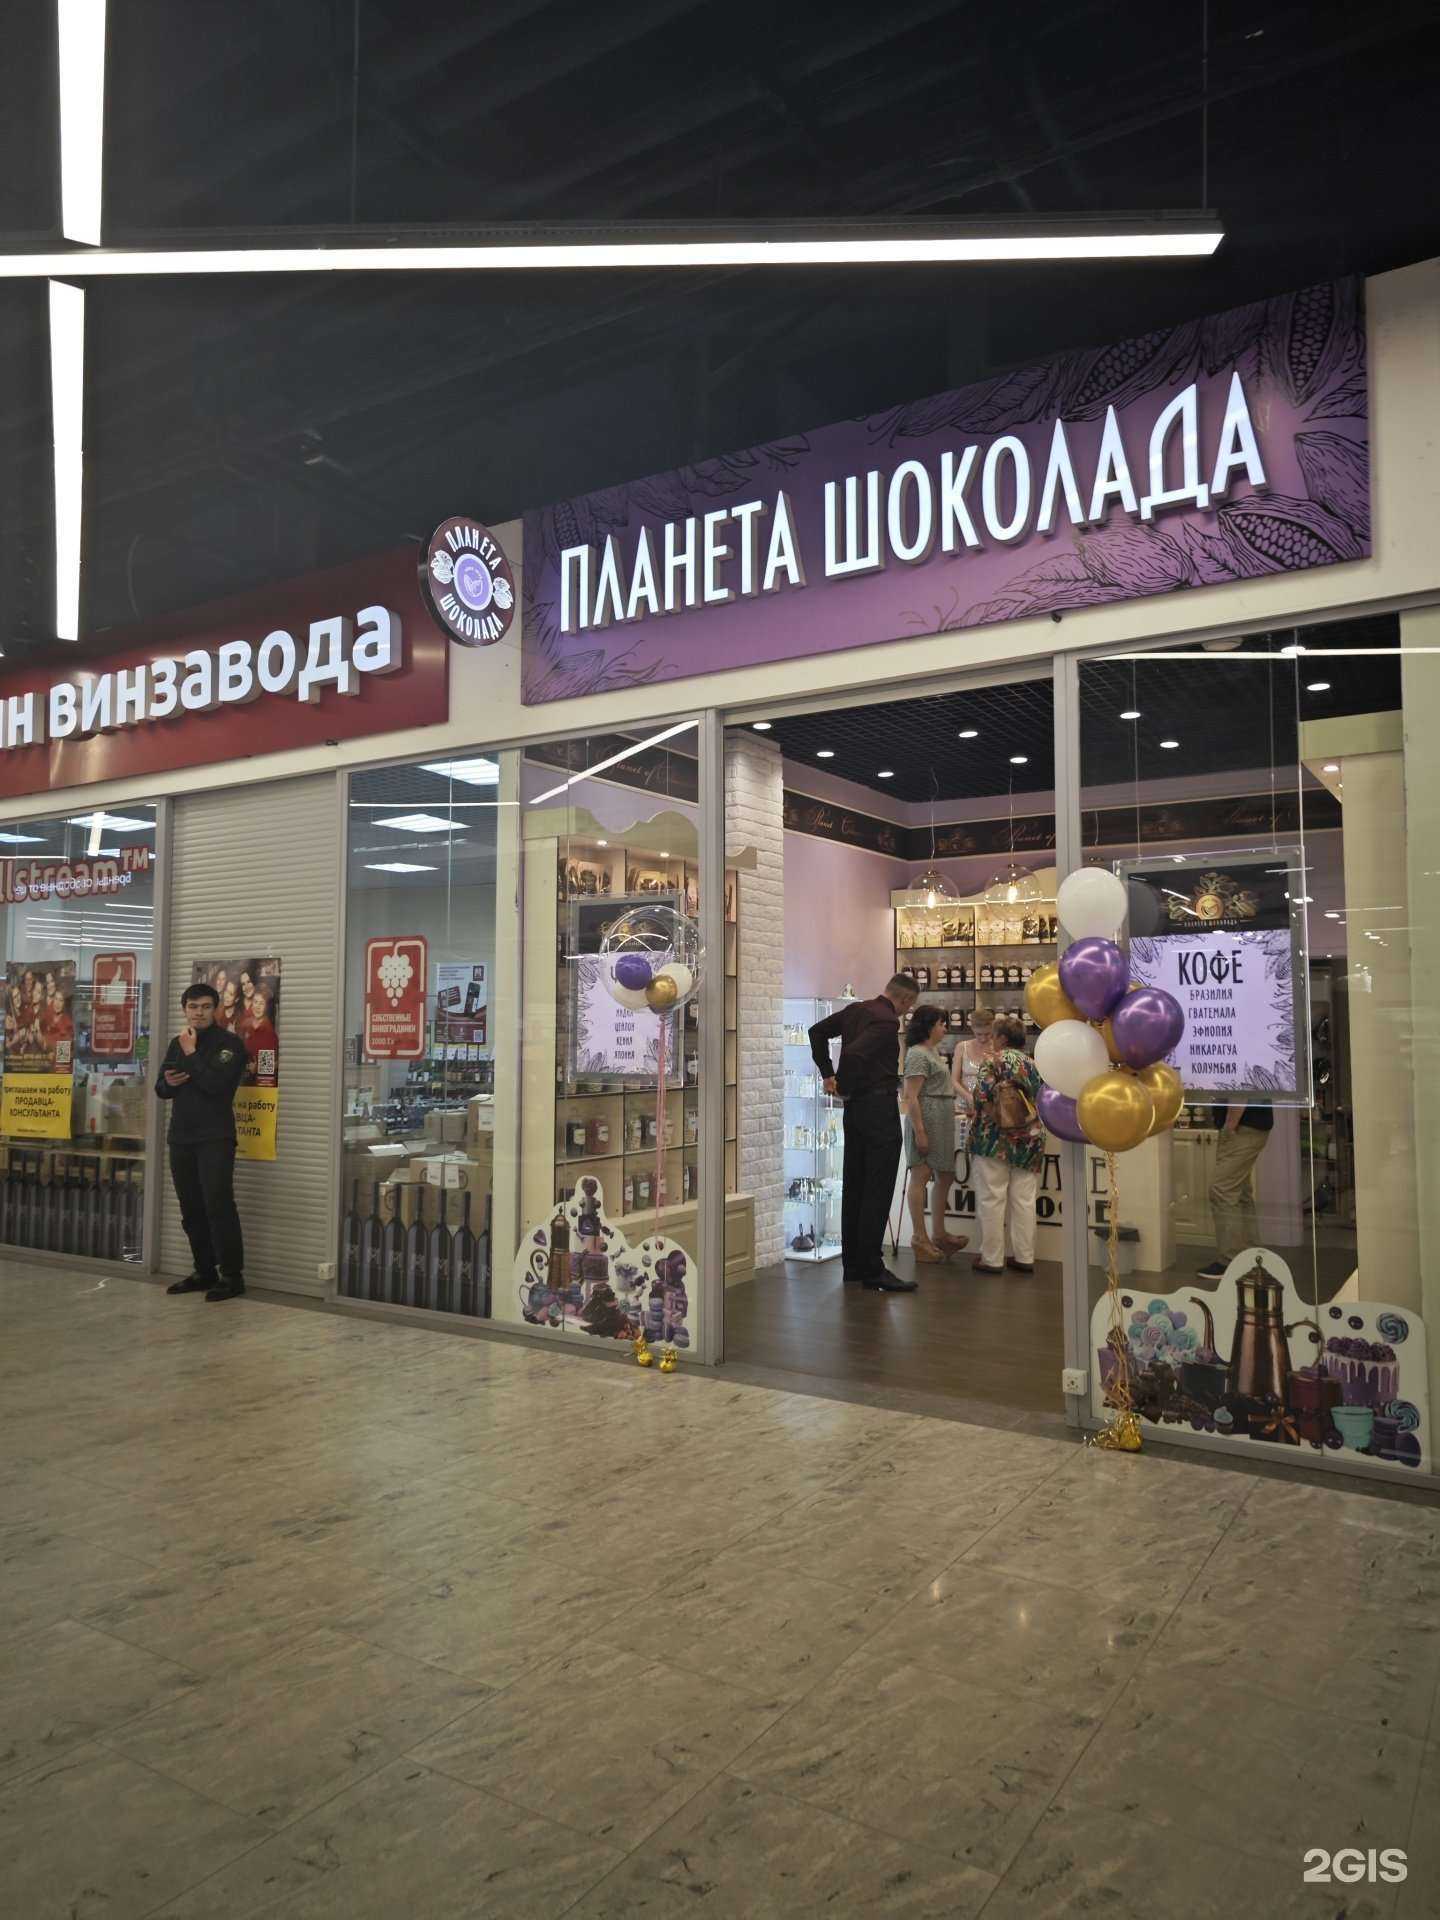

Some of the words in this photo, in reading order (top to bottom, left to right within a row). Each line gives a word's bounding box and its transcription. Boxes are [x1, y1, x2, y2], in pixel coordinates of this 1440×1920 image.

[560, 490, 804, 633] ПЛАНЕТА
[824, 371, 1267, 581] ШОКОЛАДА
[445, 526, 502, 571] ПЛАНЕТА
[440, 593, 504, 640] ШОКОЛАДА
[49, 605, 392, 739] винзавода
[1178, 949, 1244, 985] КОФЕ
[1190, 988, 1233, 1001] БРАЗИЛИЯ
[371, 1013, 412, 1023] СОБСТВЕННЫЕ
[1188, 1007, 1236, 1019] ГВАТЕМАЛА
[371, 1024, 416, 1034] ВИНОГРАДНИКИ
[1192, 1026, 1233, 1038] ЭФИОПИЯ
[1189, 1043, 1238, 1056] НИКАРАГУА
[1191, 1062, 1237, 1075] КОЛУМБИЯ
[248, 1099, 276, 1113] работу
